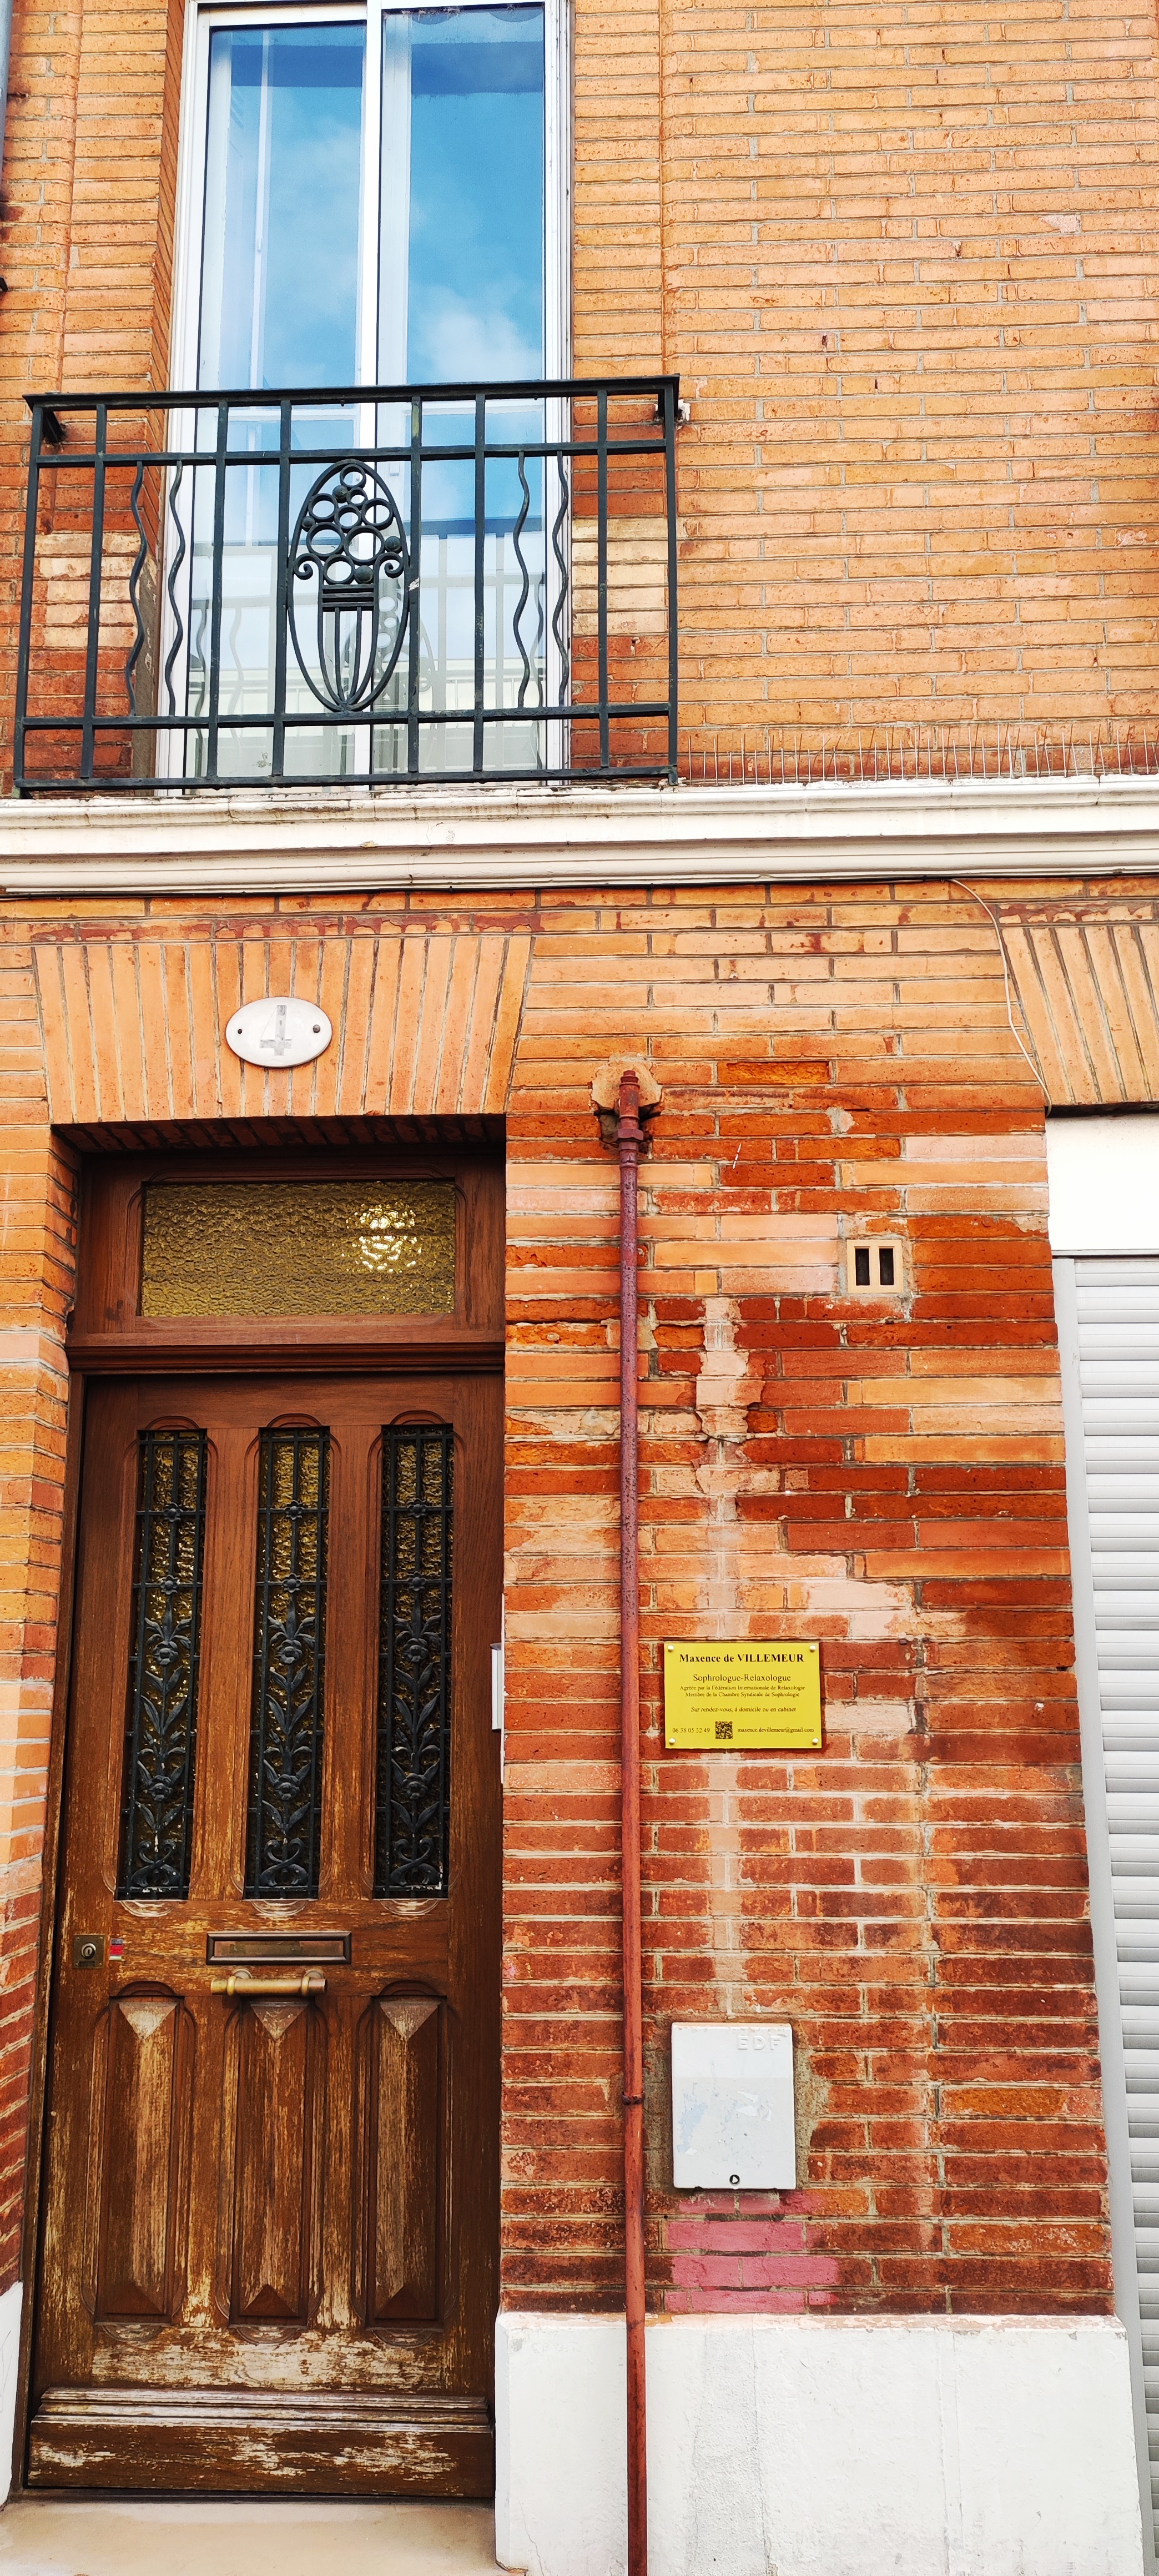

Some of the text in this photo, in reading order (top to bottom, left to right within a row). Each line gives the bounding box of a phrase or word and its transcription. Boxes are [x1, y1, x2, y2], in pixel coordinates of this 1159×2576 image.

[260, 1005, 292, 1056] 4
[679, 1654, 804, 1662] Maxence de VILLEMEUR
[693, 1673, 791, 1683] Sophrologue-Relaxologue
[738, 2035, 782, 2050] EDF
